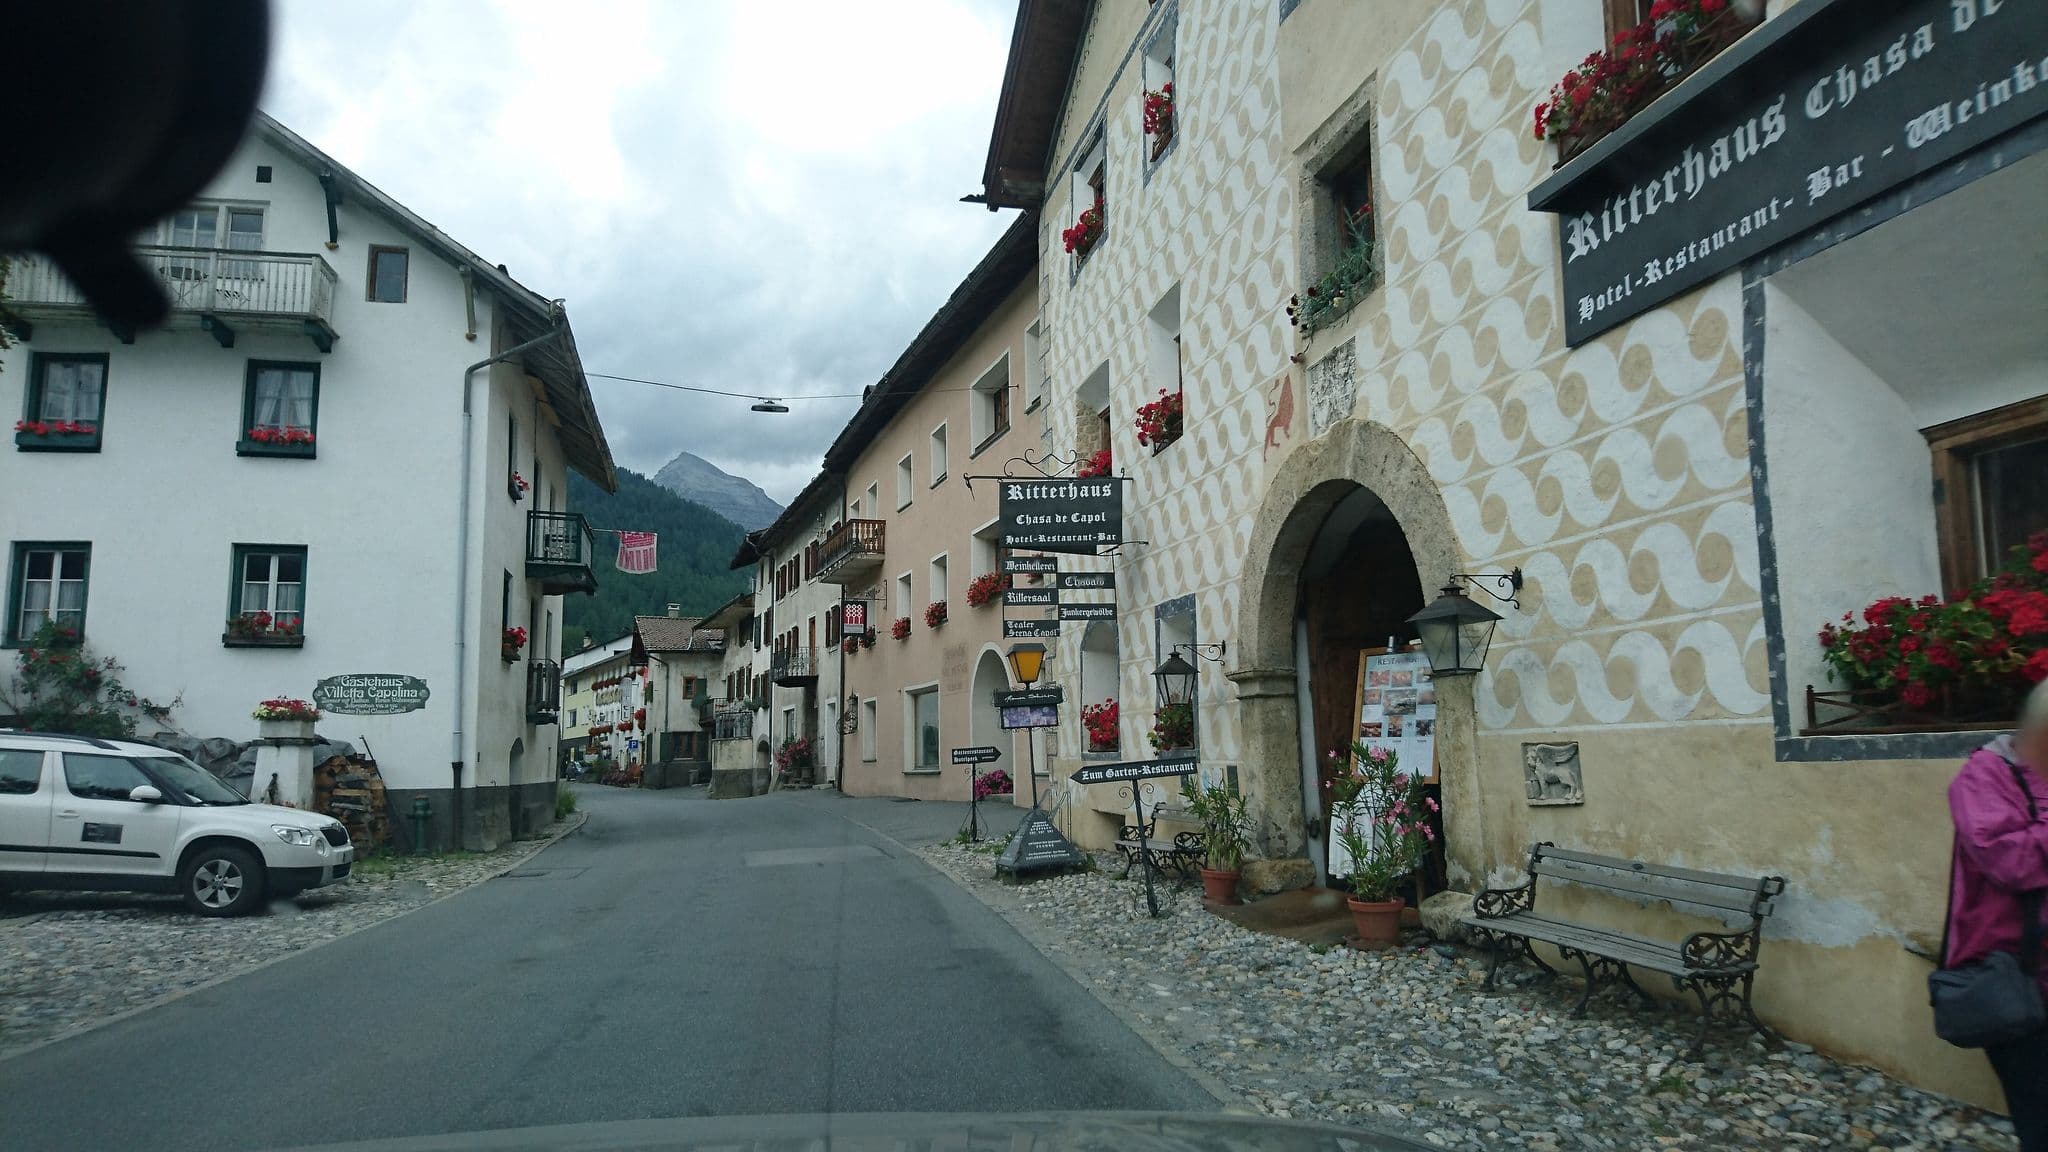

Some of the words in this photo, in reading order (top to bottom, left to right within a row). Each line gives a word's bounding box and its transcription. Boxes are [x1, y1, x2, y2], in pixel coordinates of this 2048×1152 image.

[1567, 93, 1787, 264] Ritterhaus
[1805, 22, 1935, 119] Chasa
[1806, 154, 1864, 206] Bar
[1007, 482, 1112, 500] Ritterhaus
[1016, 514, 1052, 525] Chasa
[1055, 513, 1068, 523] de
[1071, 512, 1106, 524] Capol
[341, 676, 404, 687] Gästehaus
[367, 686, 418, 698] Capolina
[1082, 771, 1103, 780] Zum
[1105, 762, 1194, 778] Garten-Restaurant
